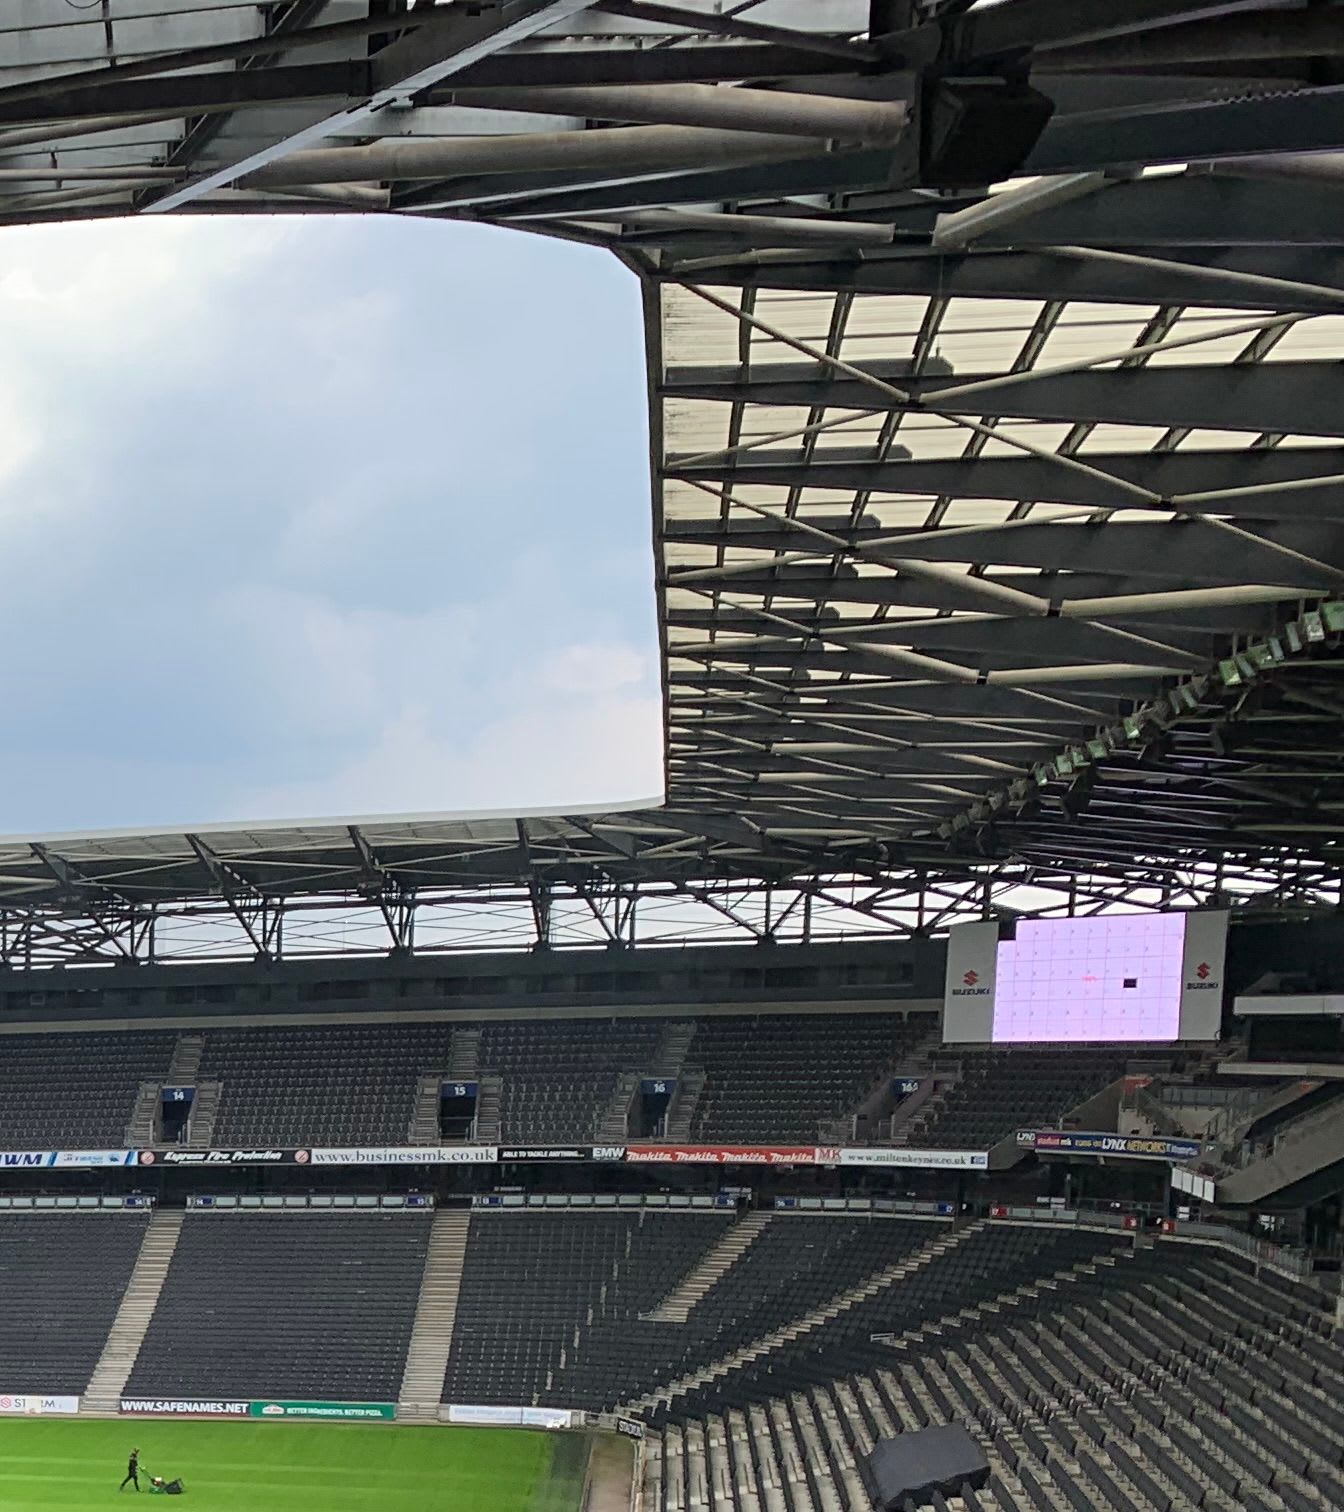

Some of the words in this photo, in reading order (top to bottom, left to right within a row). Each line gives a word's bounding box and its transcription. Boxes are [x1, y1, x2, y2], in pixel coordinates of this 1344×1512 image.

[454, 1086, 466, 1096] 15
[654, 1083, 665, 1093] 16
[173, 1091, 184, 1101] 14
[315, 1150, 495, 1163] www.businessmk.co.uk
[593, 1147, 625, 1157] EMW
[121, 1400, 248, 1413] WWW.SAFENAMES.NET
